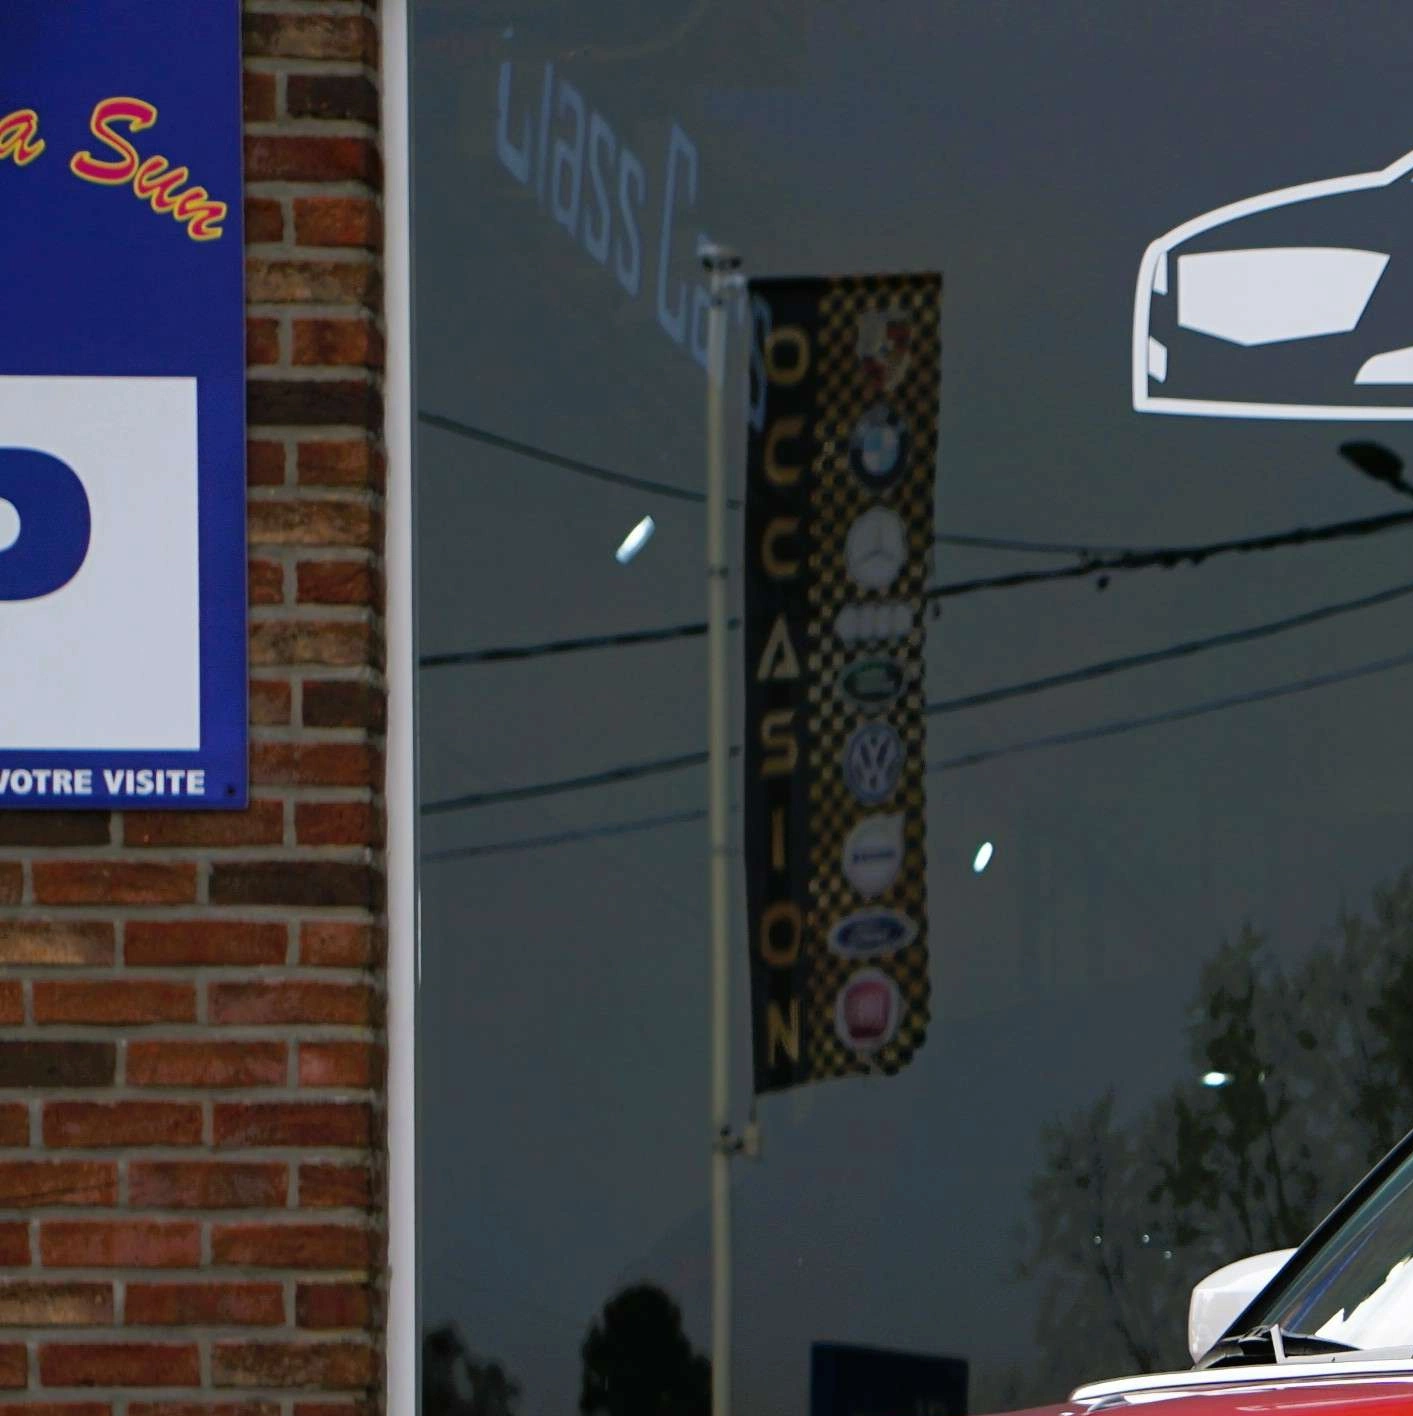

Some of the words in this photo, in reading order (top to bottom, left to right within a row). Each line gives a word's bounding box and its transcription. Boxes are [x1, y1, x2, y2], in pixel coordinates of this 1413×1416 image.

[70, 97, 227, 241] Sun
[757, 326, 811, 1068] OCCASION
[0, 768, 93, 795] VOTRE
[103, 768, 205, 796] VISITE
